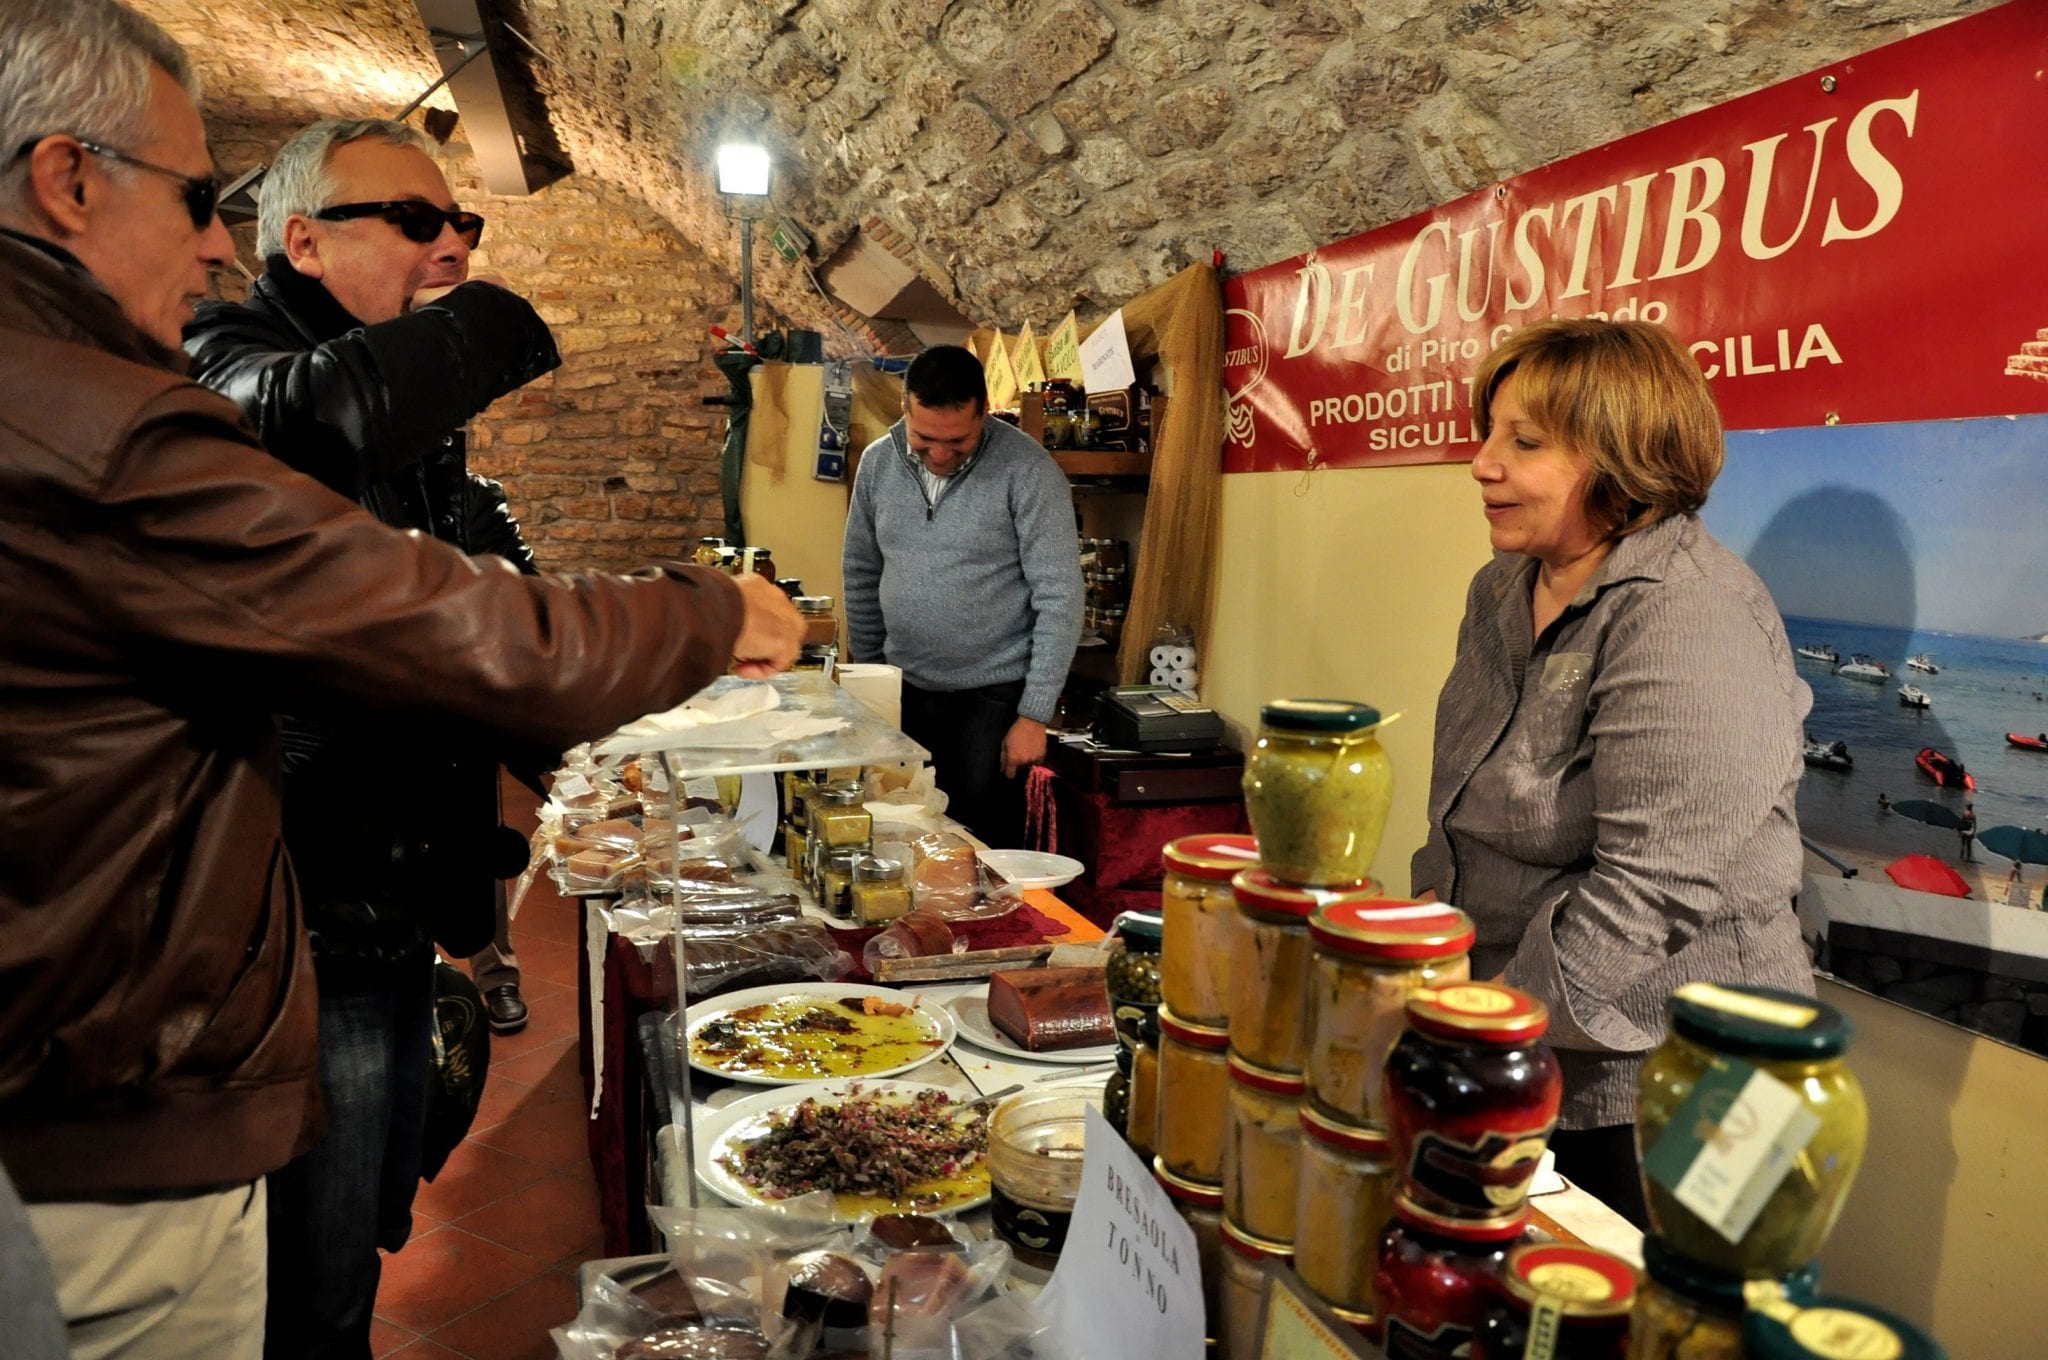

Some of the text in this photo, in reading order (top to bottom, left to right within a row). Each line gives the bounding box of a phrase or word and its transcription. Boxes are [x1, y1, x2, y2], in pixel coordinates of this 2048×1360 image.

[1284, 88, 1920, 361] DE GUSTIBUS
[1222, 344, 1259, 368] STIBUS
[1310, 380, 1453, 427] PRODOTTI
[1688, 322, 1844, 382] CILIA
[1385, 344, 1411, 374] di
[1421, 336, 1481, 369] Piro
[1368, 418, 1478, 451] SICULI
[1107, 1164, 1180, 1276] BRESAOLA
[1108, 1220, 1168, 1315] TONNO
